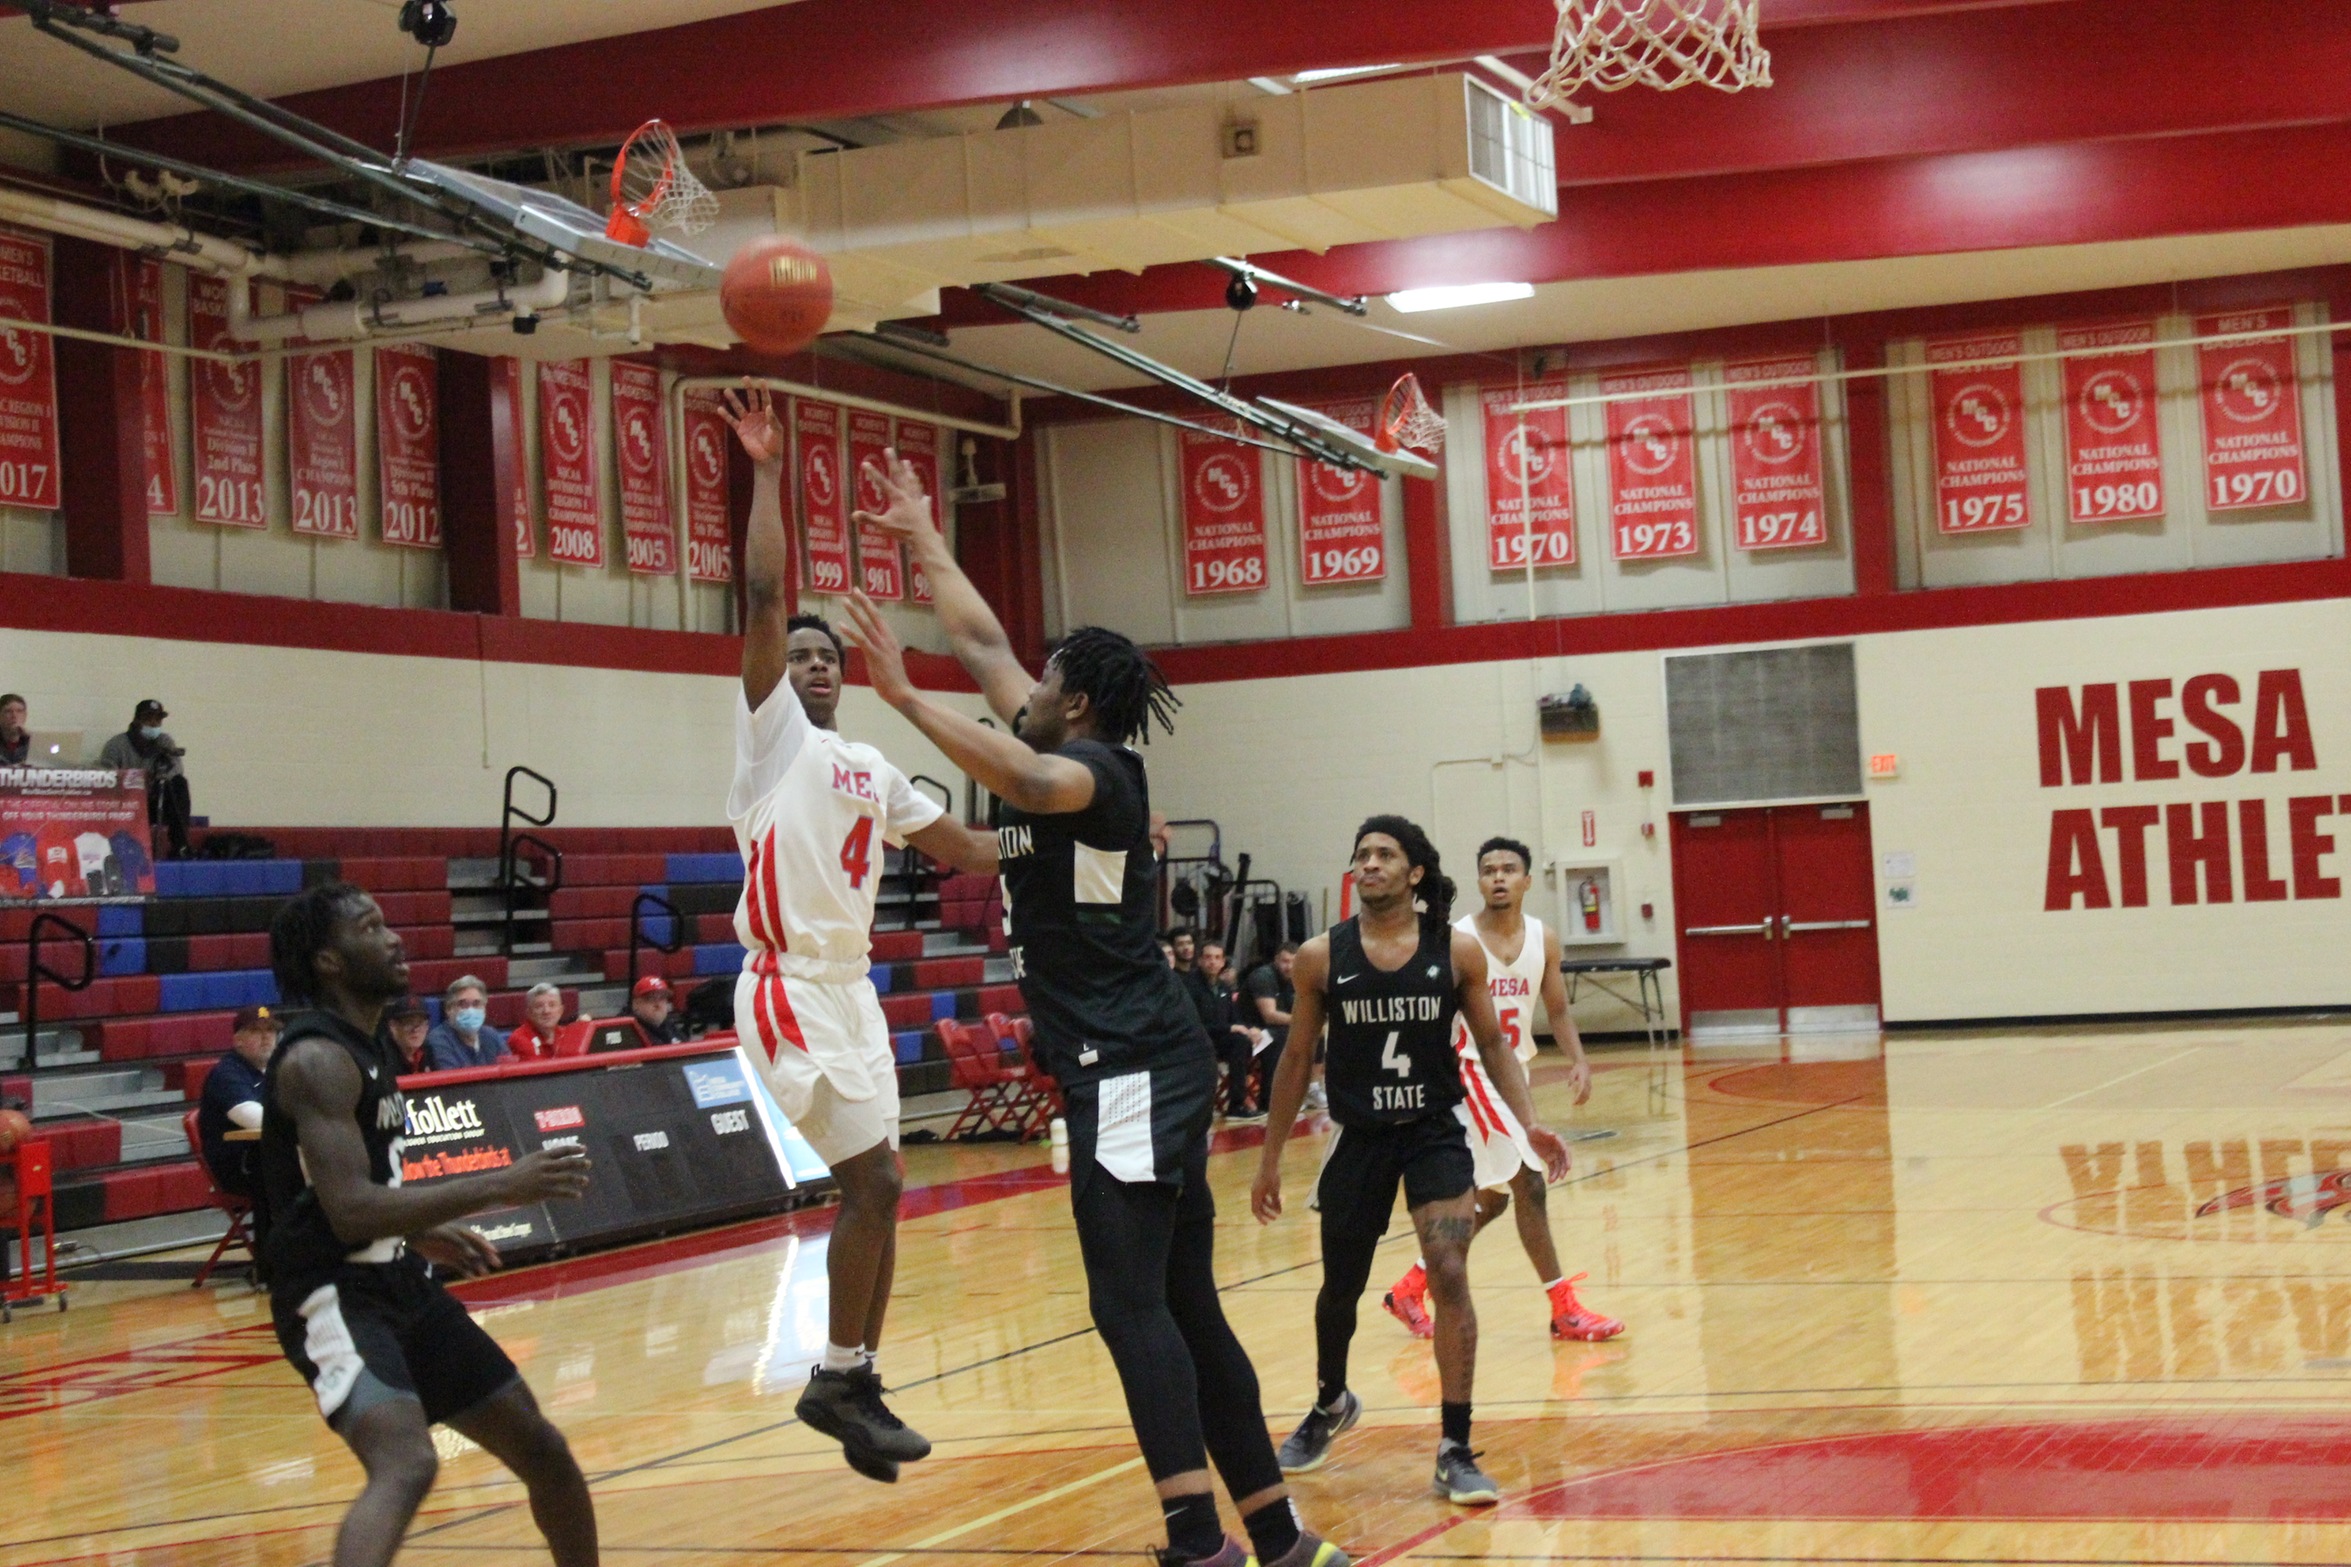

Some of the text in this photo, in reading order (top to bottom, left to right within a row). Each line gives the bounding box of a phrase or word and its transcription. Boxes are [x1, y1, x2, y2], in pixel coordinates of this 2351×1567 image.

[2079, 442, 2150, 460] NATIONAL
[2208, 445, 2298, 464] CHAMPIONS
[2215, 431, 2288, 449] NATIONAL
[1941, 469, 2025, 488] CHAMPIONS
[1946, 456, 2017, 473] NATIONAL
[2072, 457, 2159, 476] CHAMPIONS
[0, 461, 49, 500] 017
[1620, 484, 1686, 500] NATIONAL
[1743, 473, 1812, 490] NATIONAL
[2213, 469, 2297, 505] 1970
[200, 476, 263, 523] 2013
[297, 488, 356, 534] 2013
[1496, 495, 1562, 511] NATONAL
[1614, 498, 1694, 515] CHAMPIONS
[1738, 487, 1821, 505] CHAMPIONS
[1946, 493, 2024, 528] 1975
[2078, 481, 2158, 516] 1980
[387, 501, 440, 543] 2012
[1195, 522, 1255, 537] NATIONAL
[1305, 523, 1381, 541] CHAMPIONS
[1311, 511, 1373, 526] NATIONAL
[1743, 511, 1818, 543] 1974
[552, 526, 596, 559] 2008
[1189, 534, 1263, 550] CHAMPIONS
[1495, 531, 1569, 563] 1970
[1619, 521, 1691, 553] 1973
[689, 541, 732, 578] 2005
[1193, 557, 1262, 588] 1968
[1309, 546, 1380, 579] 1969
[867, 567, 893, 594] 981
[2034, 668, 2318, 788] MESA
[0, 769, 118, 788] THUNDERBIRDS
[832, 762, 880, 804] ME
[839, 814, 875, 890] 4
[2044, 793, 2351, 912] ATHLE
[1341, 995, 1441, 1025] WILLISTON
[1381, 1031, 1412, 1078] 4
[1373, 1083, 1425, 1112] STATE
[405, 1095, 483, 1136] follett
[711, 1109, 749, 1135] GUEST
[633, 1131, 669, 1151] PERIOD
